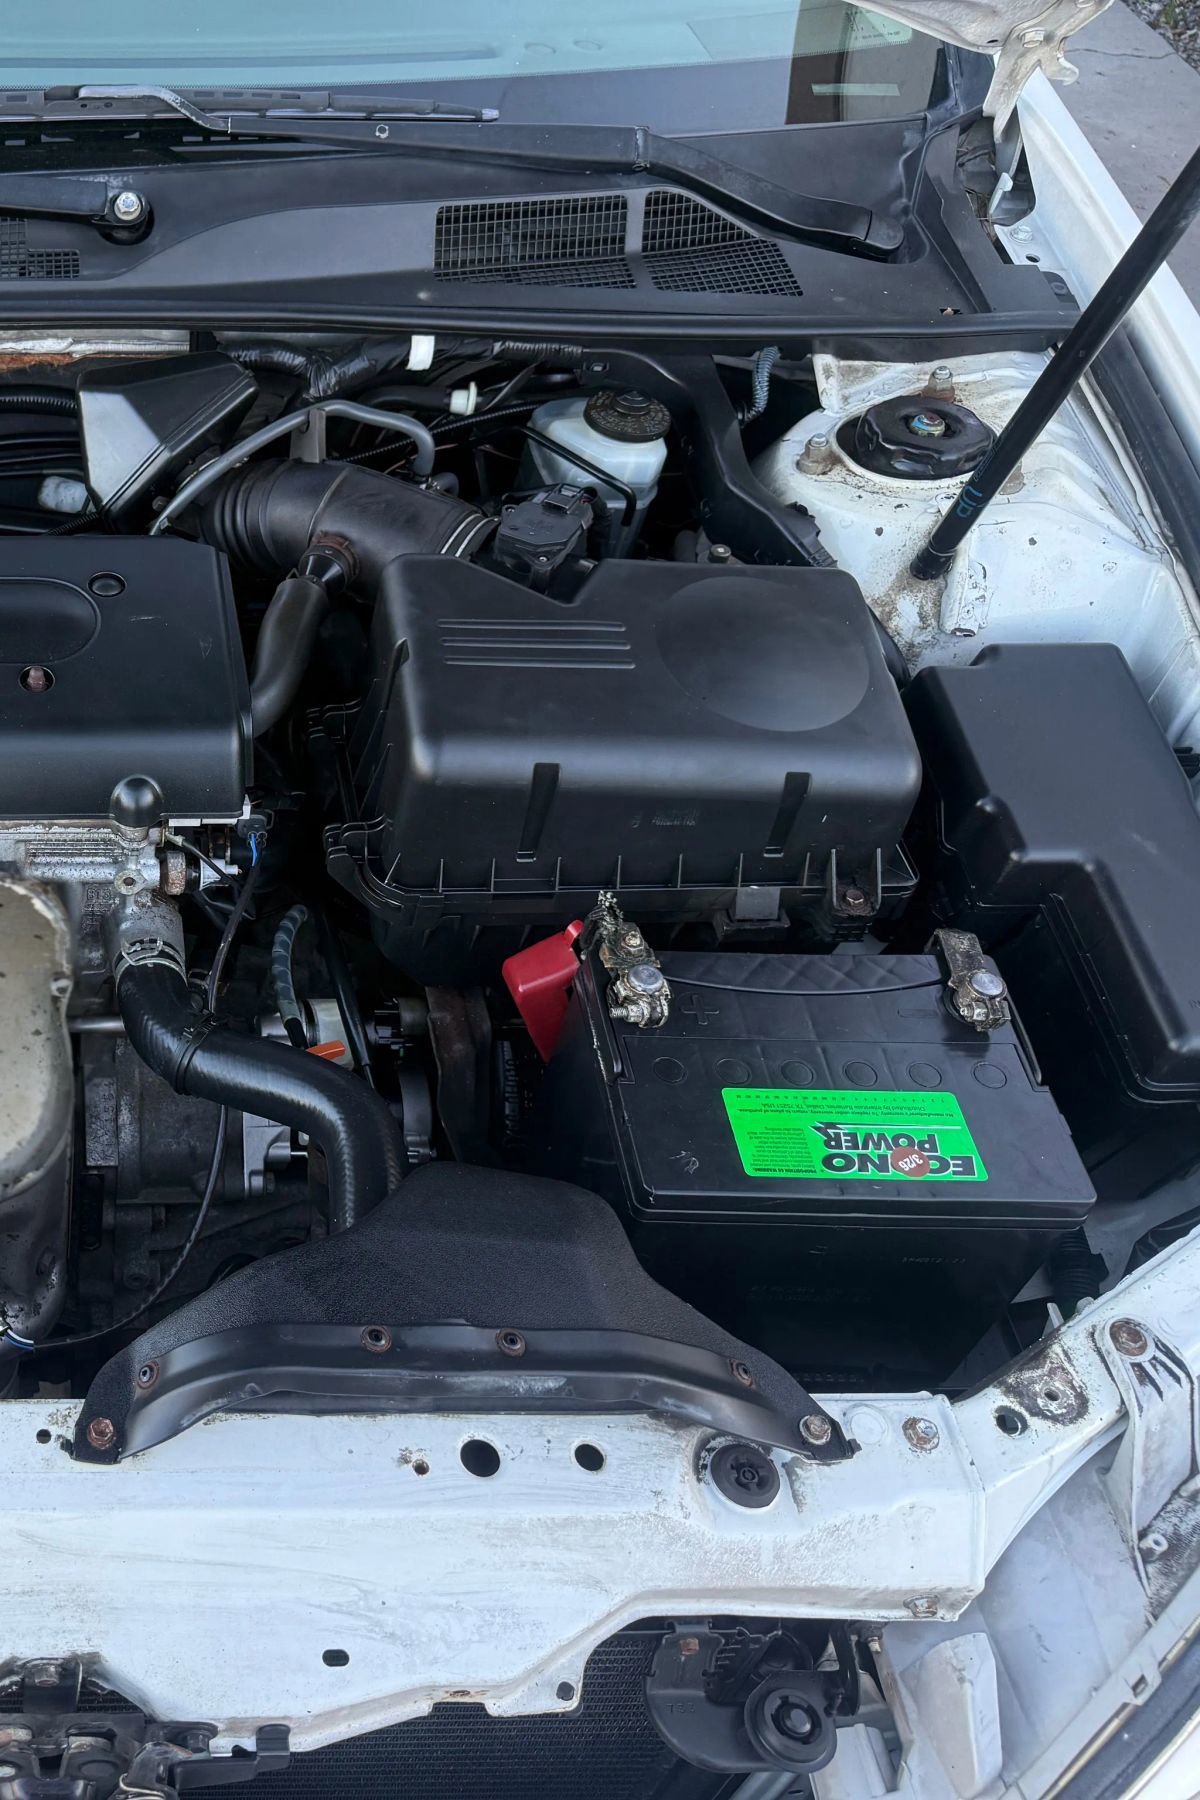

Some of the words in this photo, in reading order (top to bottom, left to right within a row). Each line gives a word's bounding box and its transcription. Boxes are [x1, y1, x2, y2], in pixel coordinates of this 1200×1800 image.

[809, 1124, 939, 1154] POWER
[821, 1152, 977, 1178] ECNO
[898, 1153, 923, 1172] 3/26
